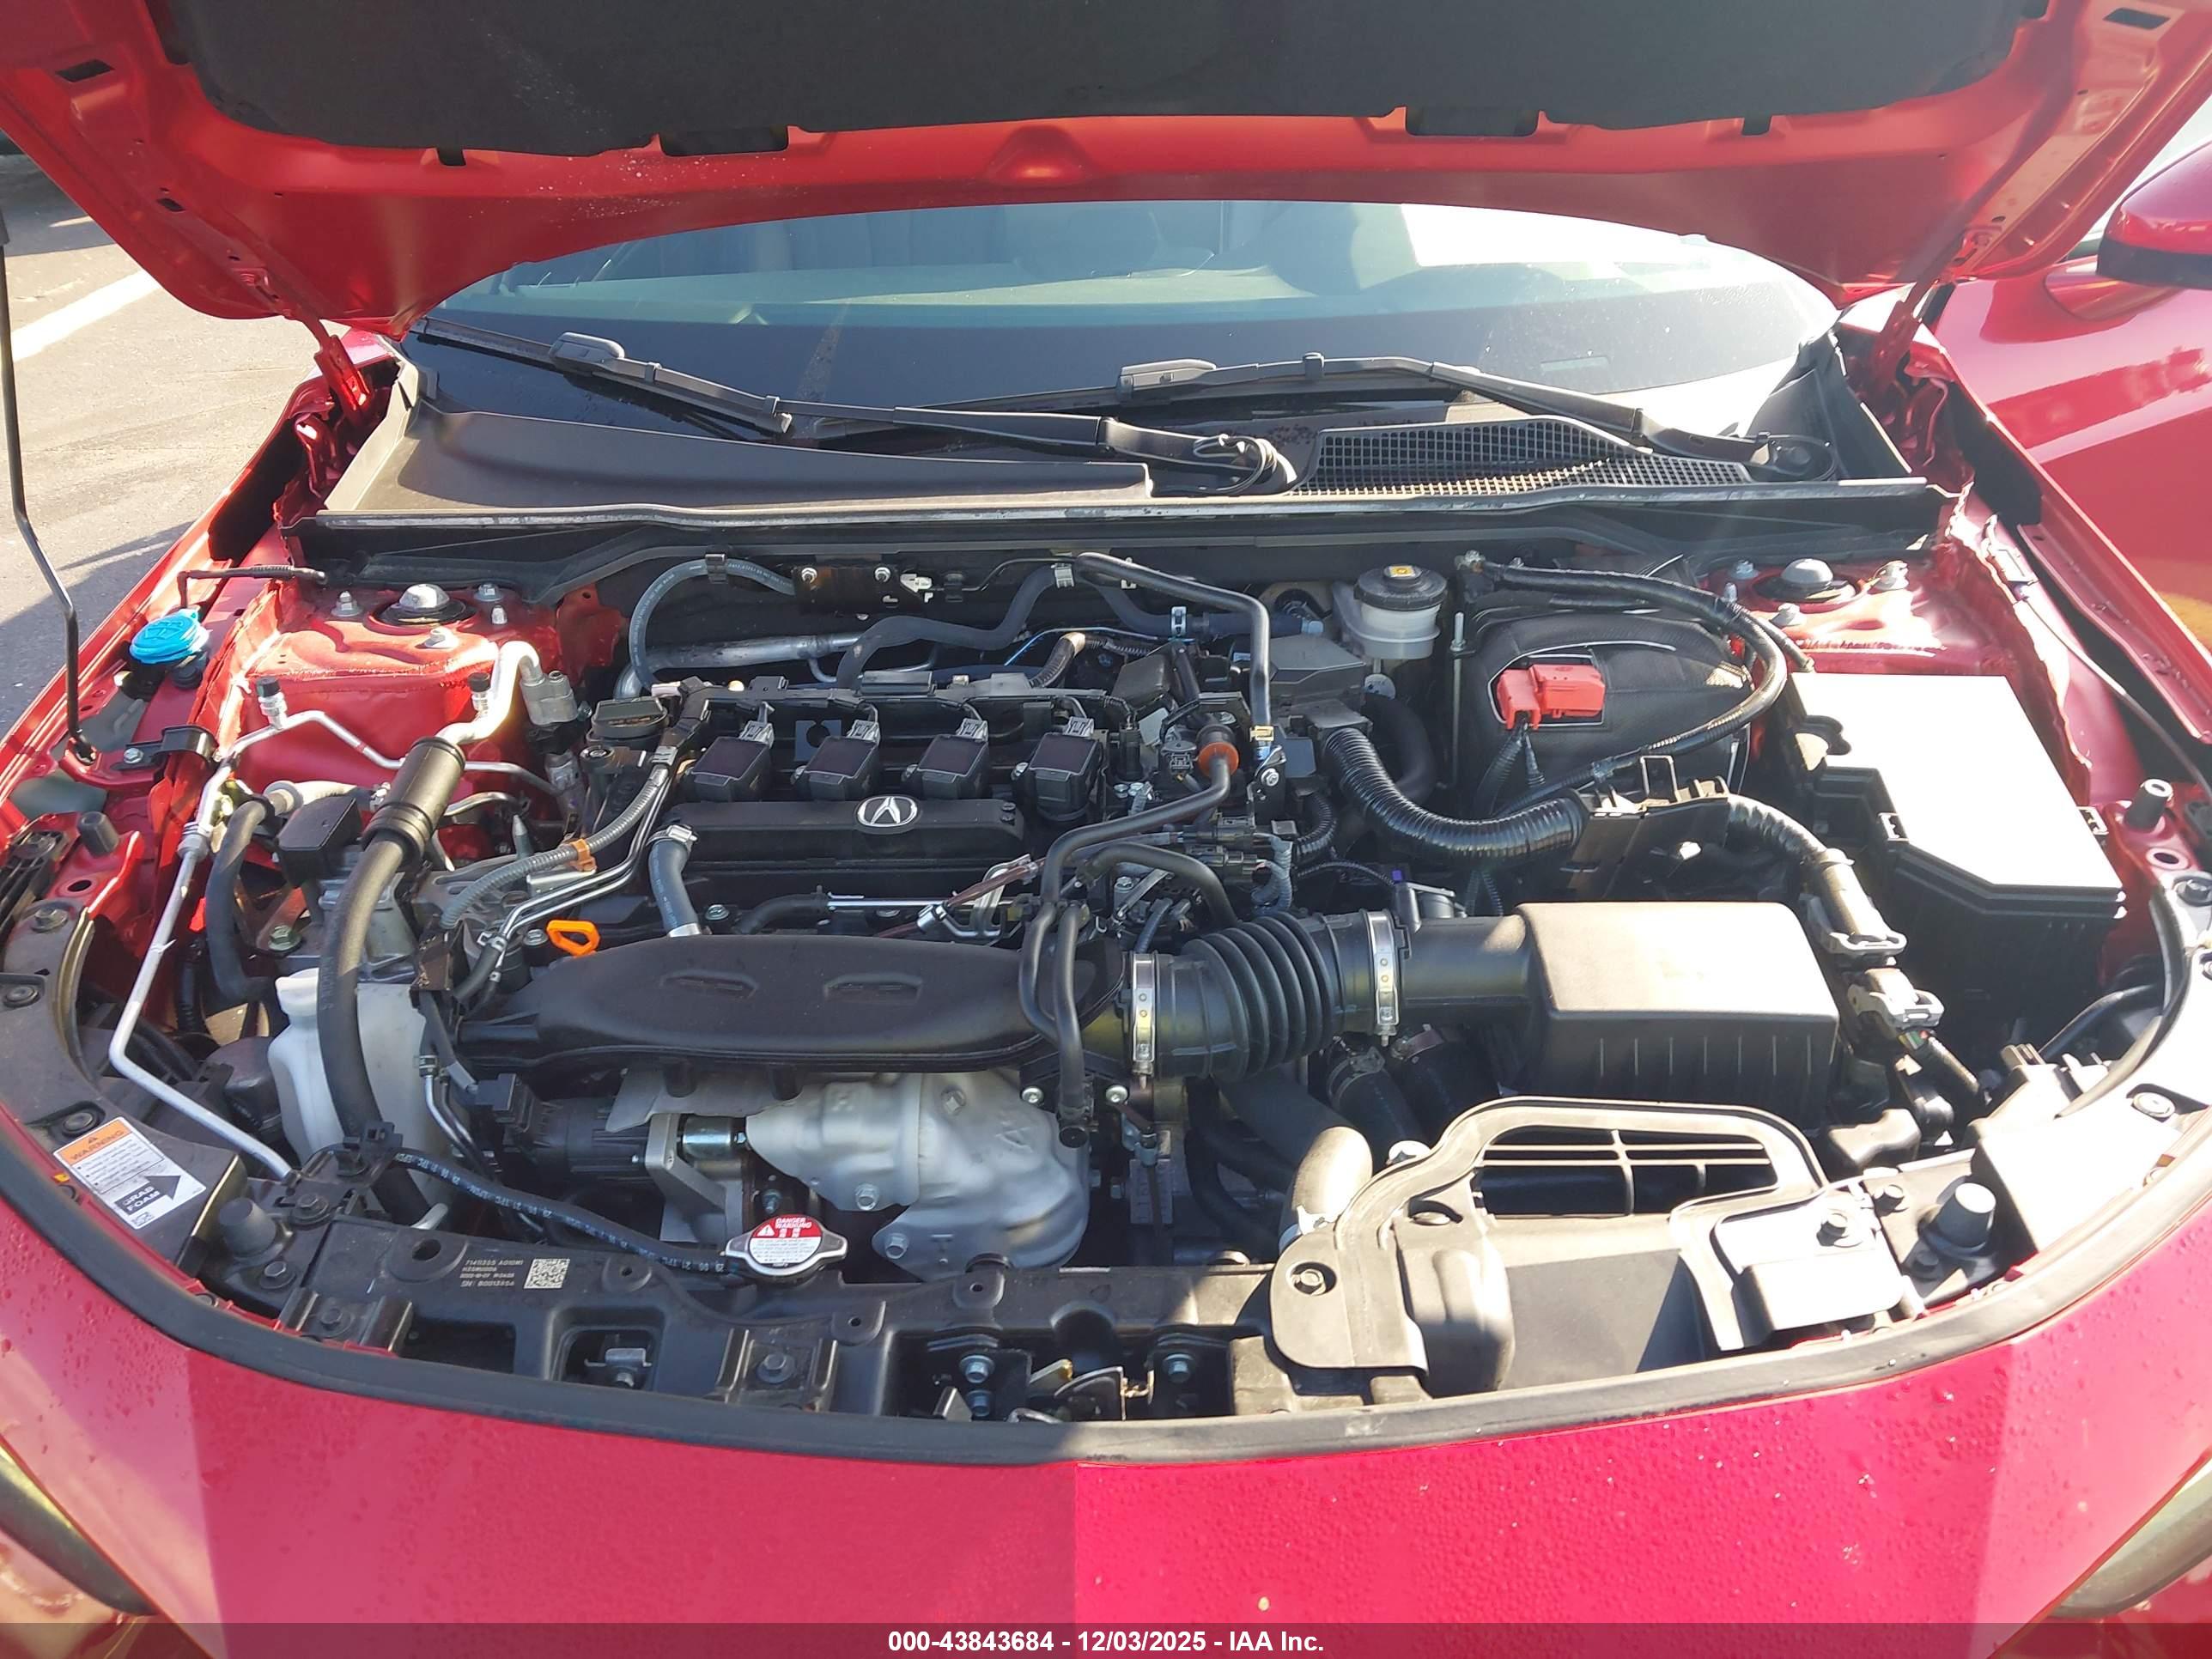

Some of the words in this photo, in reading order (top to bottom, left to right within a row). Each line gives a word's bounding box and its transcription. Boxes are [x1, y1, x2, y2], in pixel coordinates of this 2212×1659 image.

[70, 1129, 125, 1161] WARNING
[123, 1186, 155, 1206] GRAB
[126, 1191, 161, 1212] FOAM
